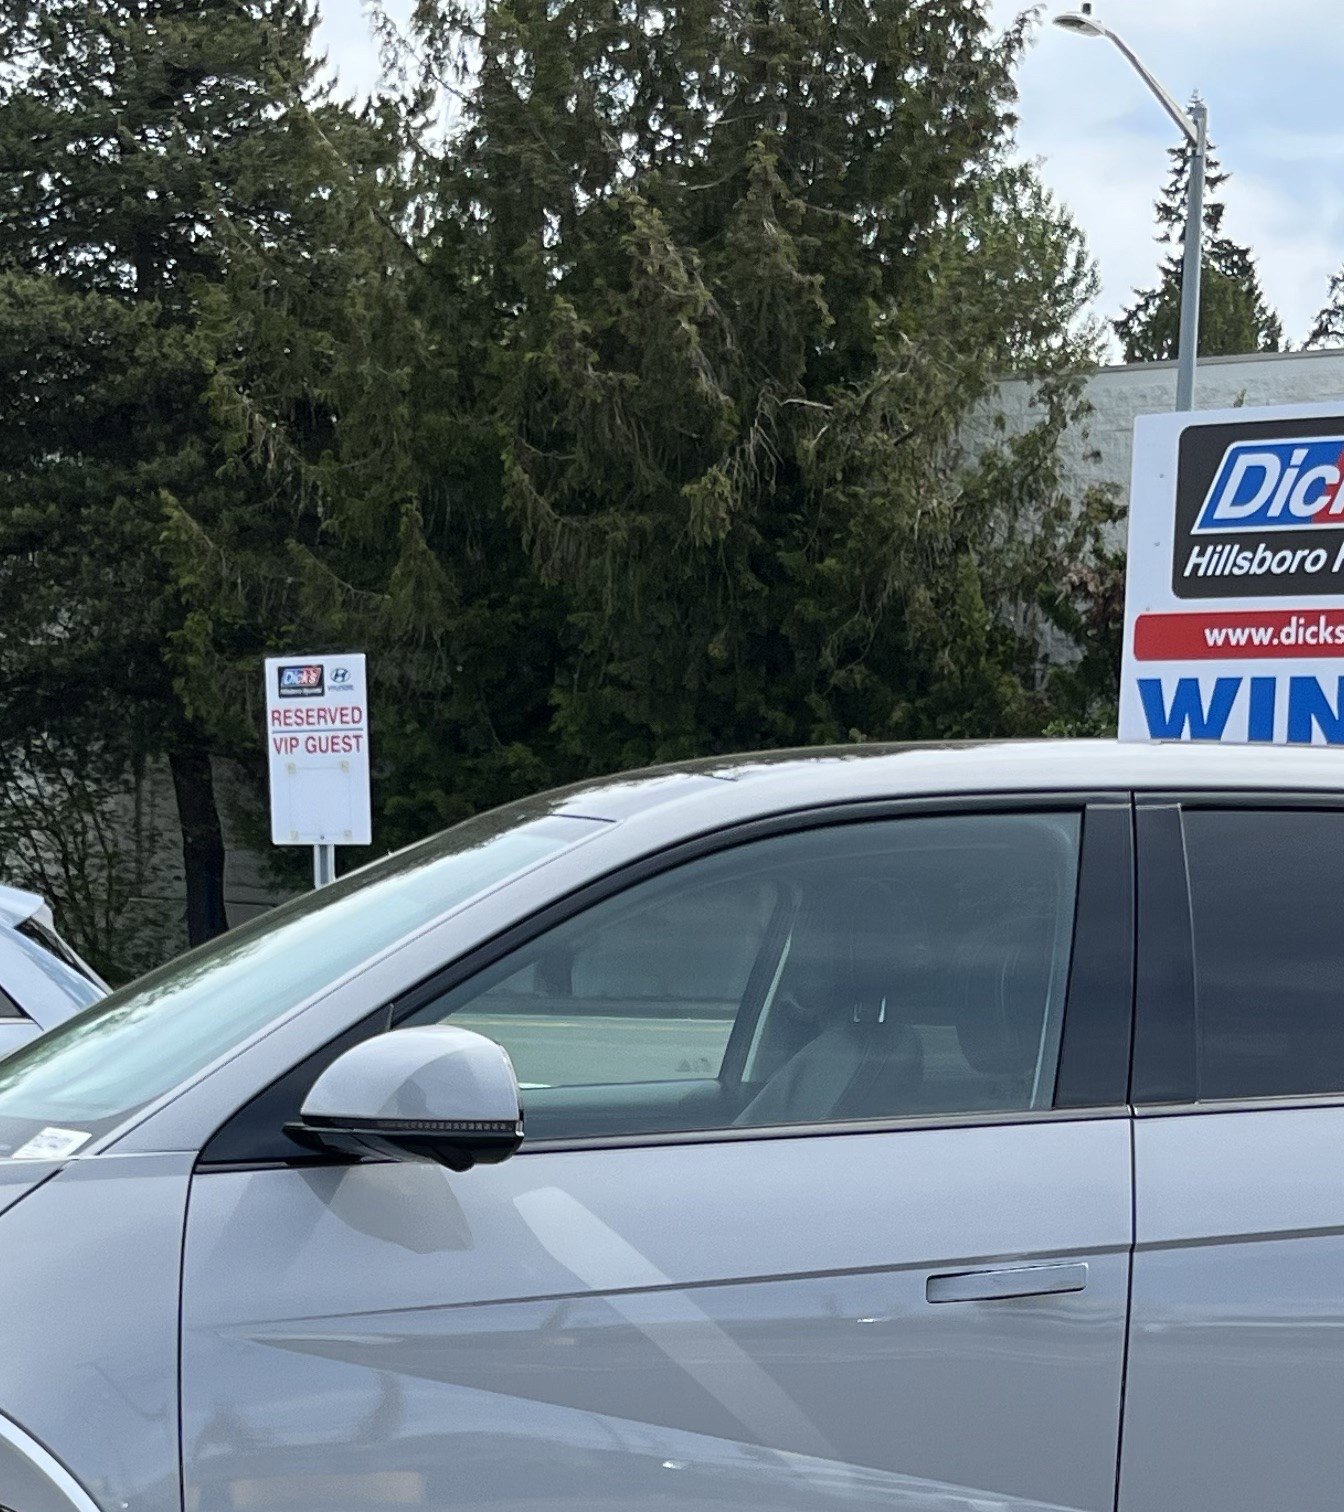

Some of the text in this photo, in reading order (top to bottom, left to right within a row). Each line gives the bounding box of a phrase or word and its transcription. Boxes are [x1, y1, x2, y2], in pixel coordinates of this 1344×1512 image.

[1183, 543, 1327, 577] Hillsboro
[271, 706, 363, 727] RESERVED
[273, 734, 364, 755] VIP GUEST
